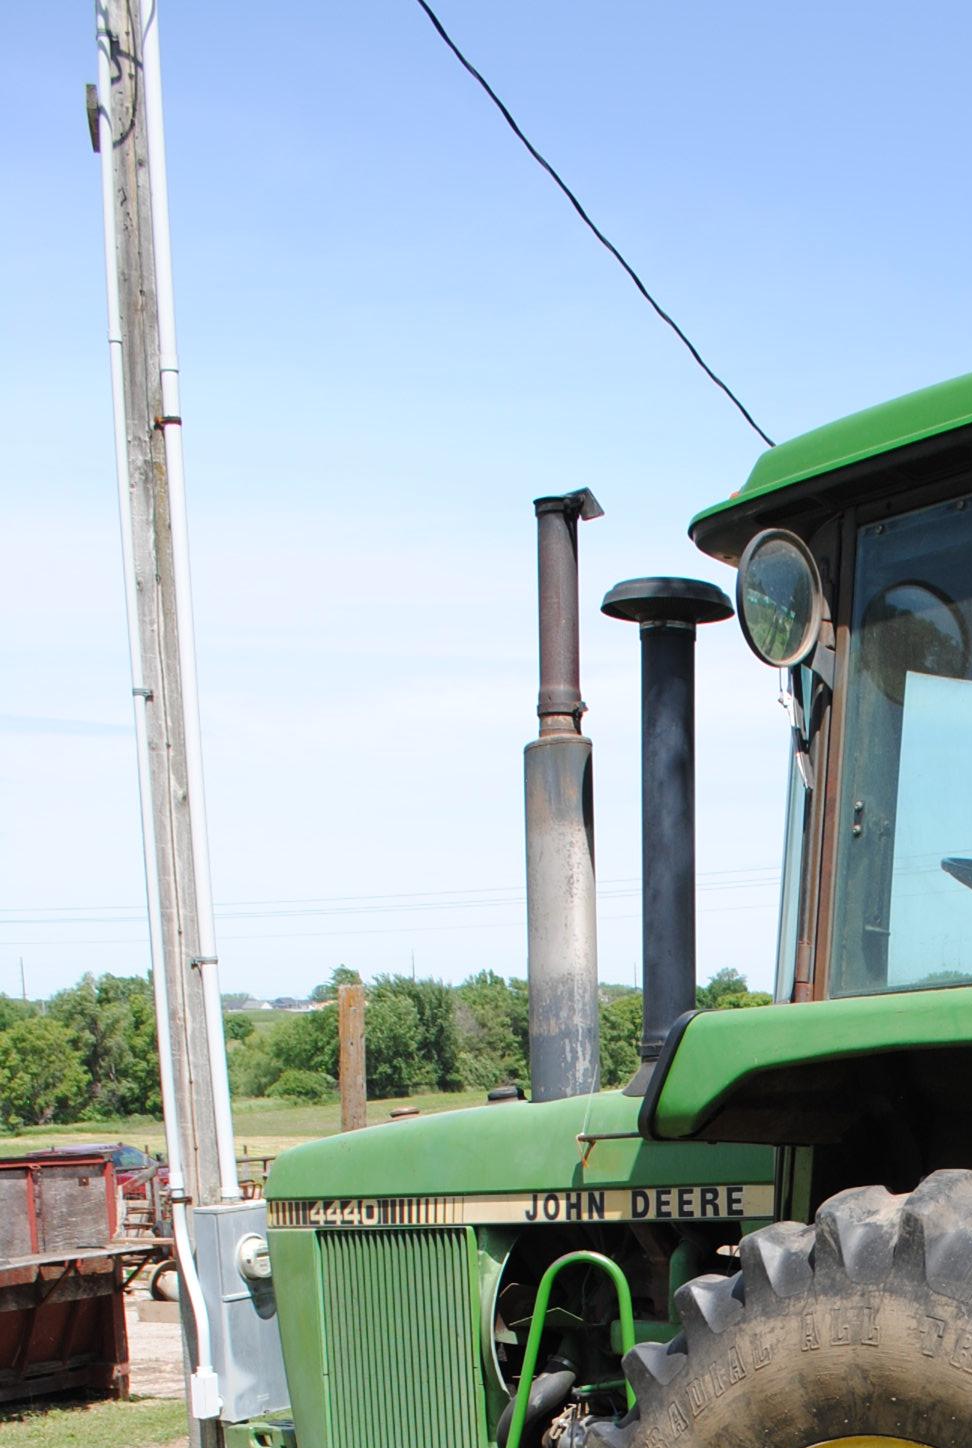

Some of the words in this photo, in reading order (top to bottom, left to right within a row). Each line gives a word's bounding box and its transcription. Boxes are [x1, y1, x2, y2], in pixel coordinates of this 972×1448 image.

[310, 1200, 379, 1225] 4440
[525, 1191, 605, 1221] JOHN
[631, 1186, 744, 1219] DEERE
[799, 1306, 880, 1353] ALL
